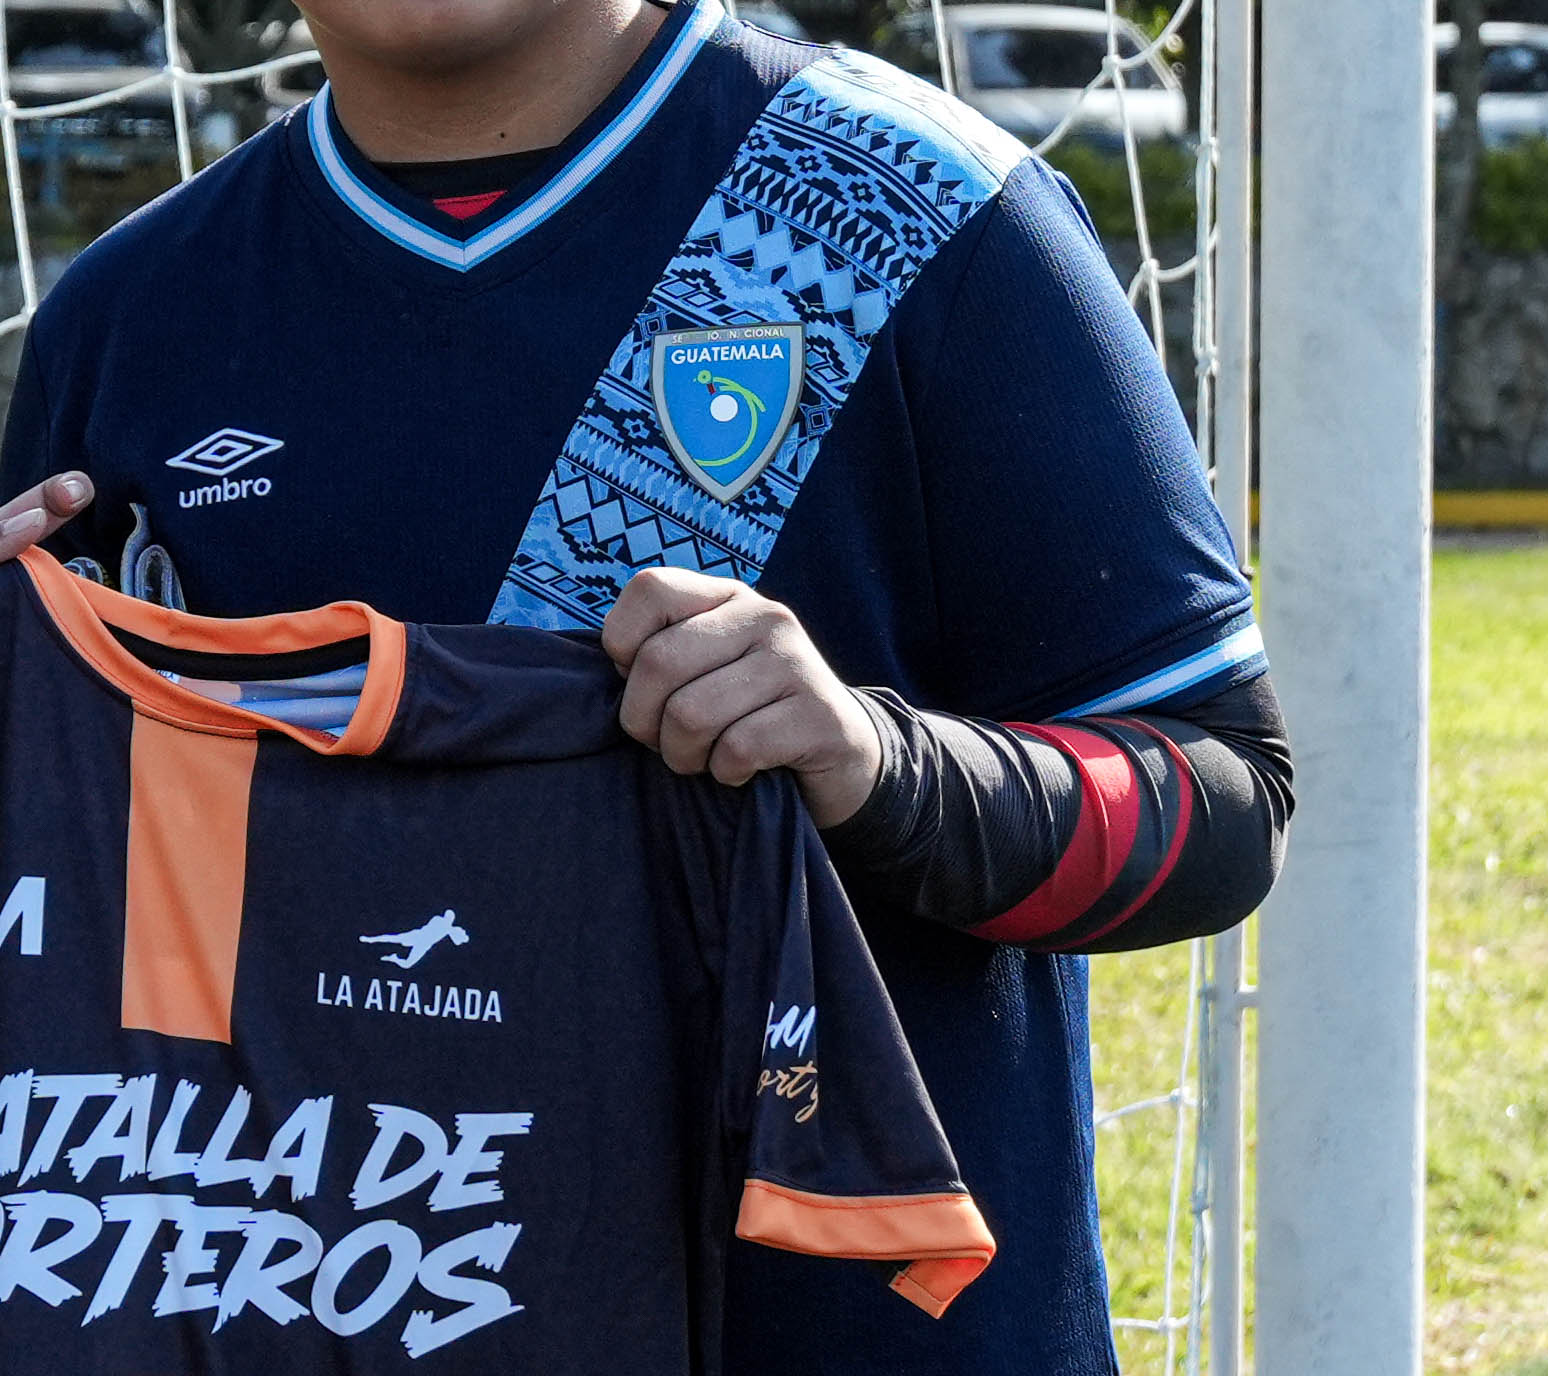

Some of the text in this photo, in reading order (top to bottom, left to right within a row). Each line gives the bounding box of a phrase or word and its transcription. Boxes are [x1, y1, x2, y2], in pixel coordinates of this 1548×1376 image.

[729, 327, 785, 339] NCIONAL
[671, 344, 784, 365] GUATEMALA
[178, 477, 272, 509] umbro
[317, 971, 503, 1024] LA ATAJADA
[348, 1103, 534, 1212] DE
